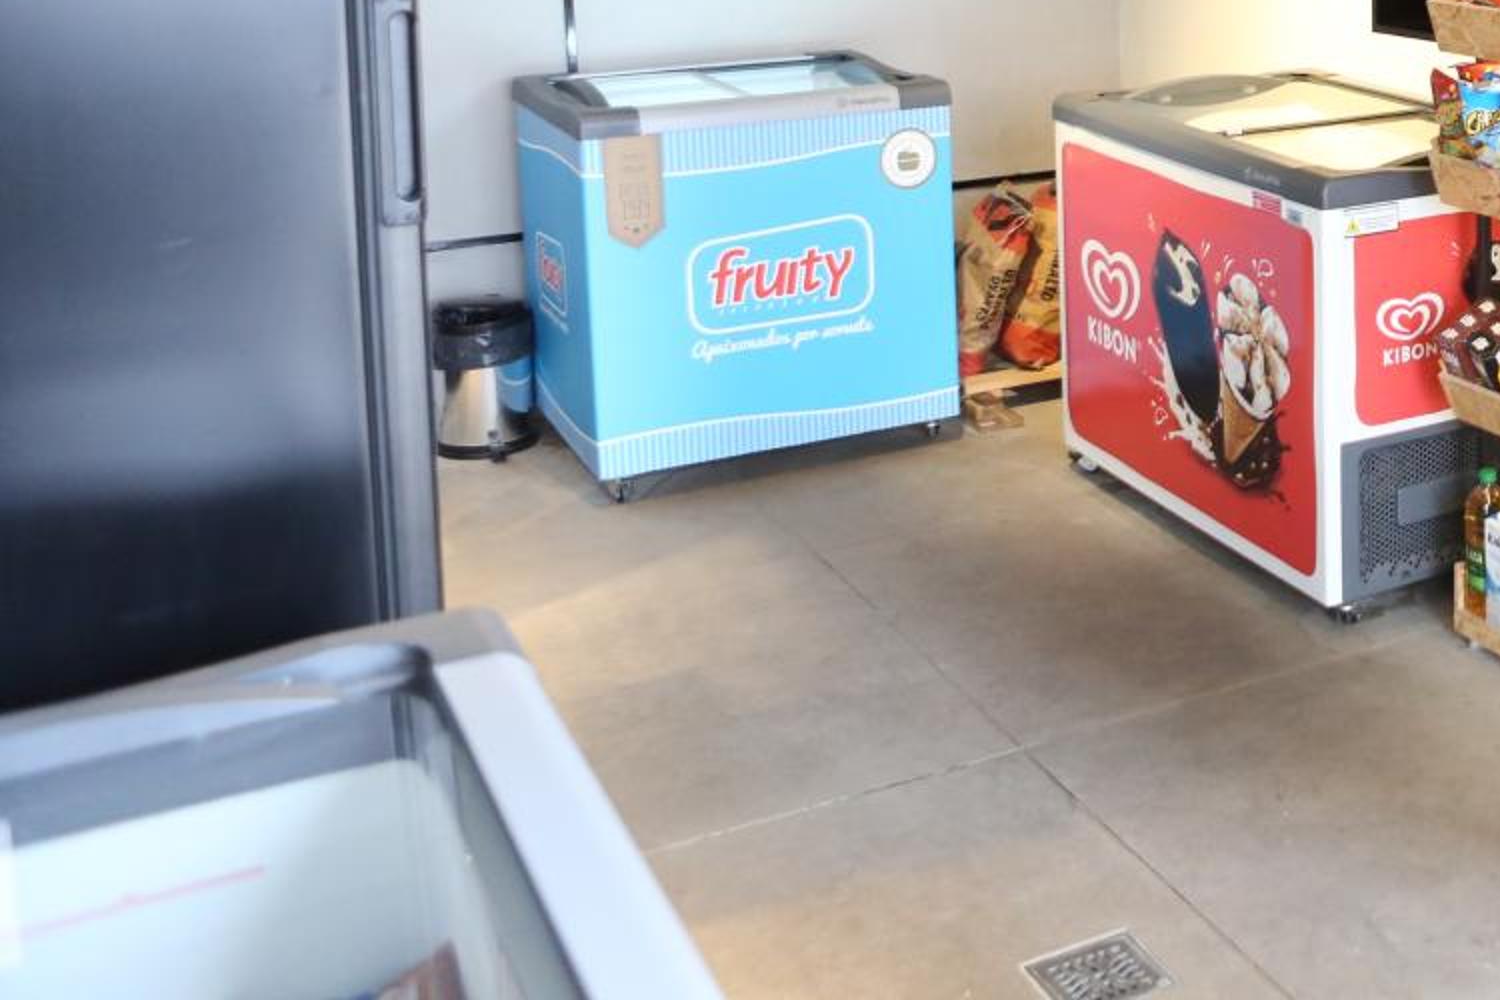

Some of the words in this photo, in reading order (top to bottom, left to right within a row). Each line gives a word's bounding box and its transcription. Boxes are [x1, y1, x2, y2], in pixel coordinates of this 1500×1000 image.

[709, 246, 855, 307] fruity
[1087, 315, 1138, 365] KIBON
[1382, 342, 1438, 370] KIBON
